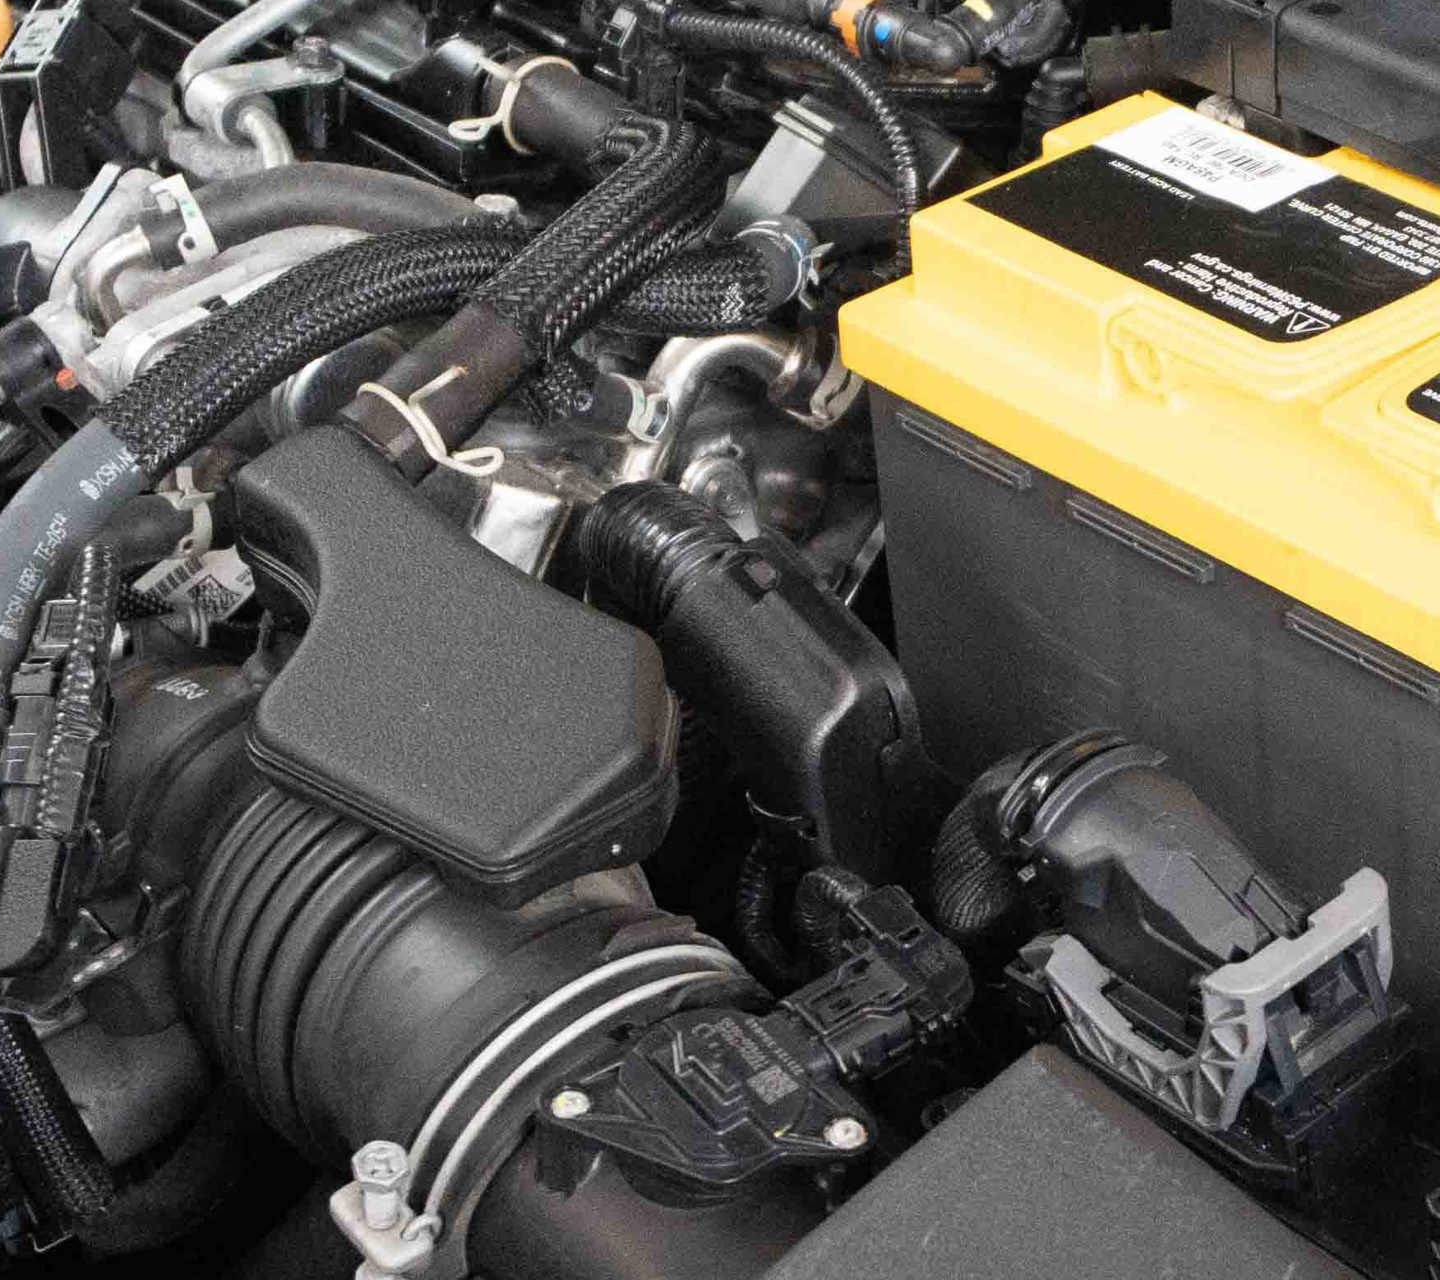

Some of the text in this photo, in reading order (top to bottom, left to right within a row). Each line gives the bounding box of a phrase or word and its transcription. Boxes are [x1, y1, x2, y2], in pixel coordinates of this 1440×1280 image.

[1167, 186, 1195, 200] LEAD
[1182, 262, 1218, 282] Harm
[1143, 258, 1284, 324] WARNING: Cancer and
[1208, 277, 1294, 317] Reproductive
